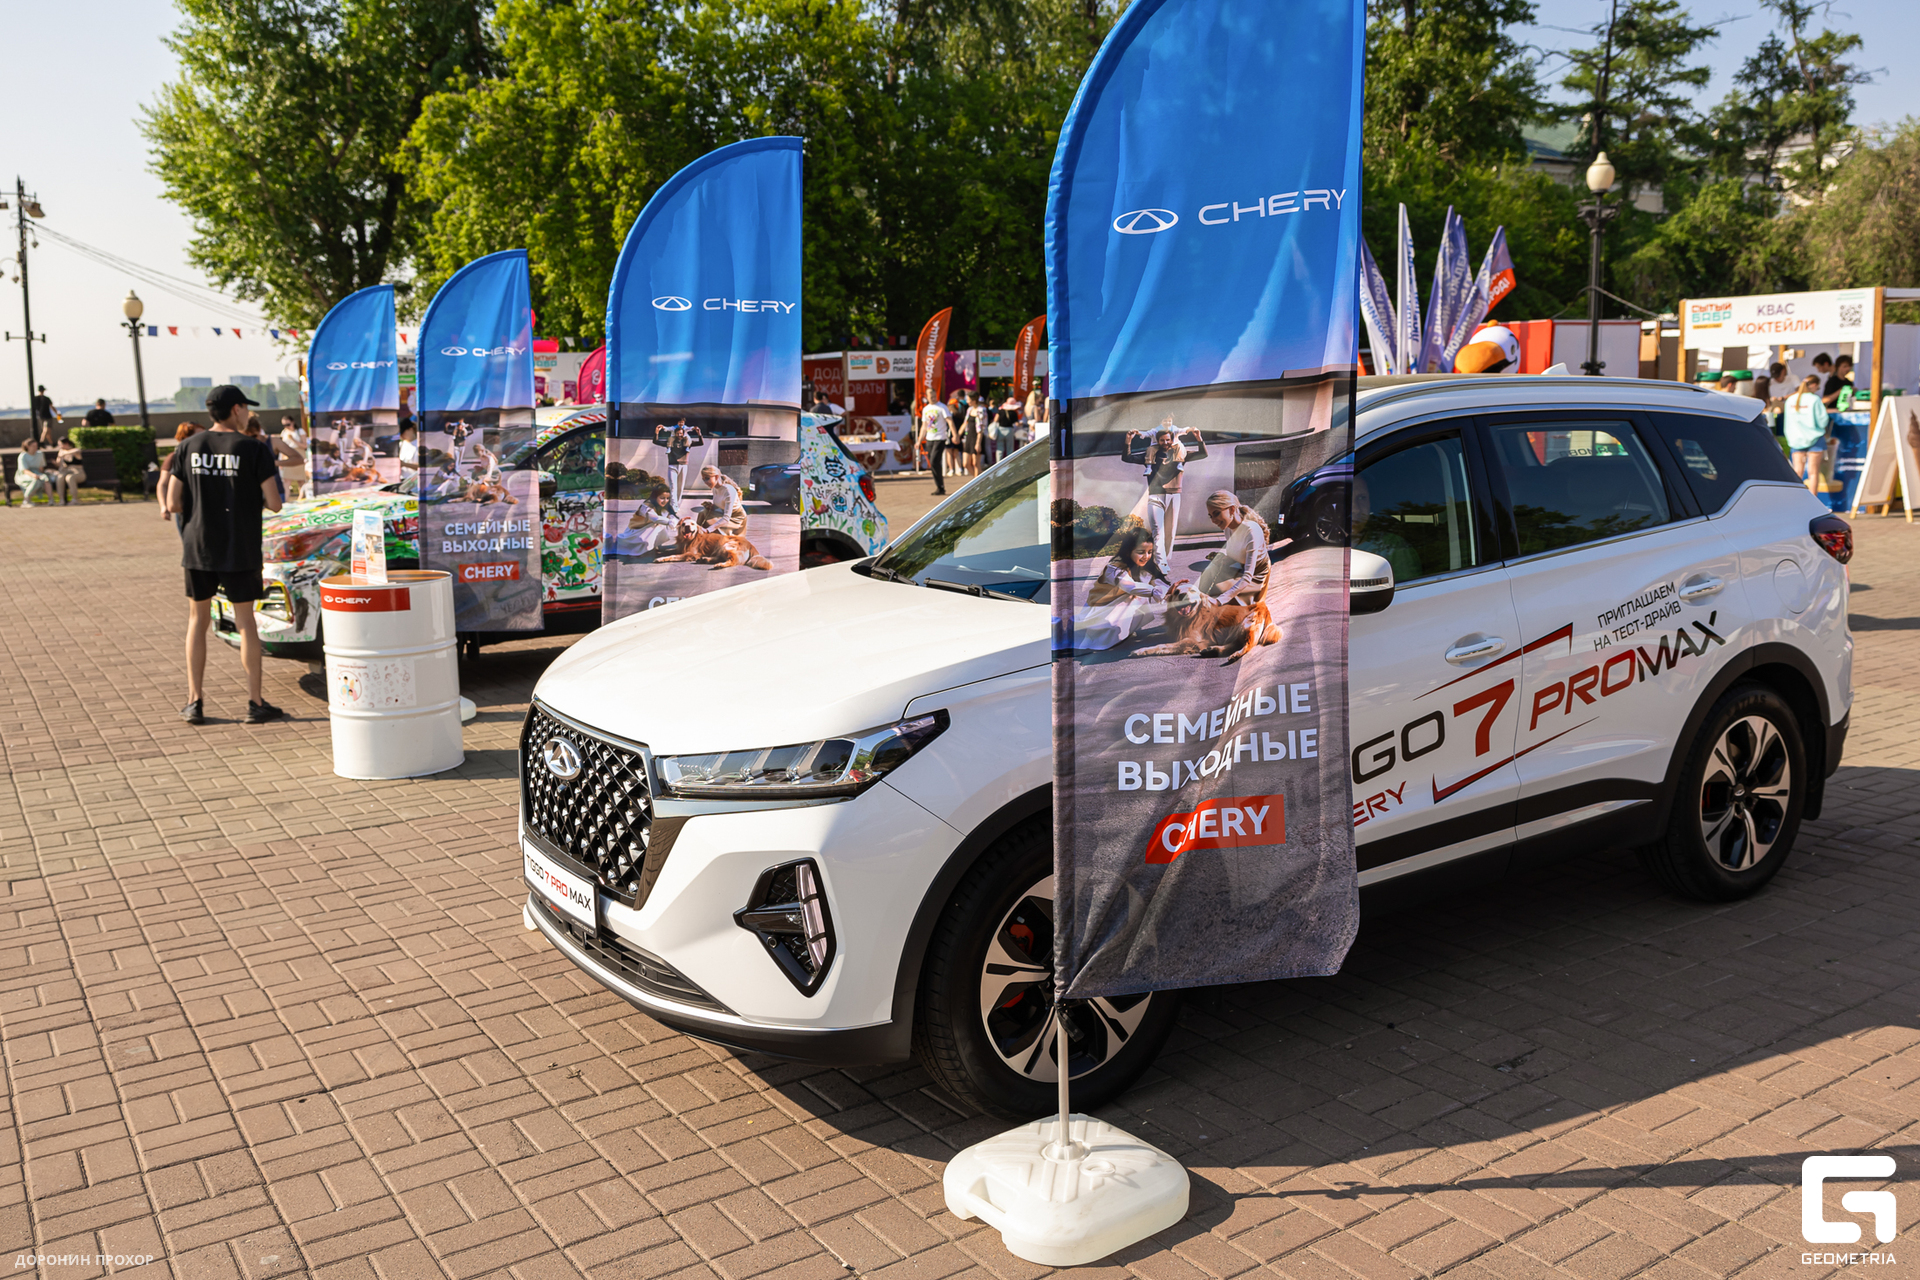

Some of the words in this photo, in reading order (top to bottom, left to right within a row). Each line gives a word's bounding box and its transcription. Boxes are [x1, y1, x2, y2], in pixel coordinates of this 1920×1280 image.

[1198, 189, 1347, 226] CHERY
[703, 298, 796, 314] CHERY
[1757, 303, 1795, 316] КВАС
[1737, 318, 1815, 335] КОКТЕЙЛИ
[472, 346, 526, 358] CHERY
[351, 361, 394, 370] CHERY
[191, 452, 241, 470] BUTIN
[444, 519, 531, 536] СЕМЕЙНЫЕ
[442, 536, 534, 553] ВЫХОДНЫЕ
[464, 564, 514, 580] CHERY
[334, 597, 372, 606] CHERY
[1597, 581, 1676, 628] ПРИГЛАШАЕМ
[1593, 634, 1611, 652] НА
[1612, 600, 1682, 642] ТЕСТ-ДРАЙВ
[1124, 683, 1311, 745] СЕМЕЙНЫЕ
[1352, 710, 1445, 785] GO
[1453, 678, 1515, 758] 7
[1118, 728, 1318, 791] ВЫХОДНЫЕ
[1353, 780, 1407, 828] ERY
[1161, 804, 1270, 853] CHERY
[550, 875, 568, 898] PRO
[569, 886, 592, 912] MAX
